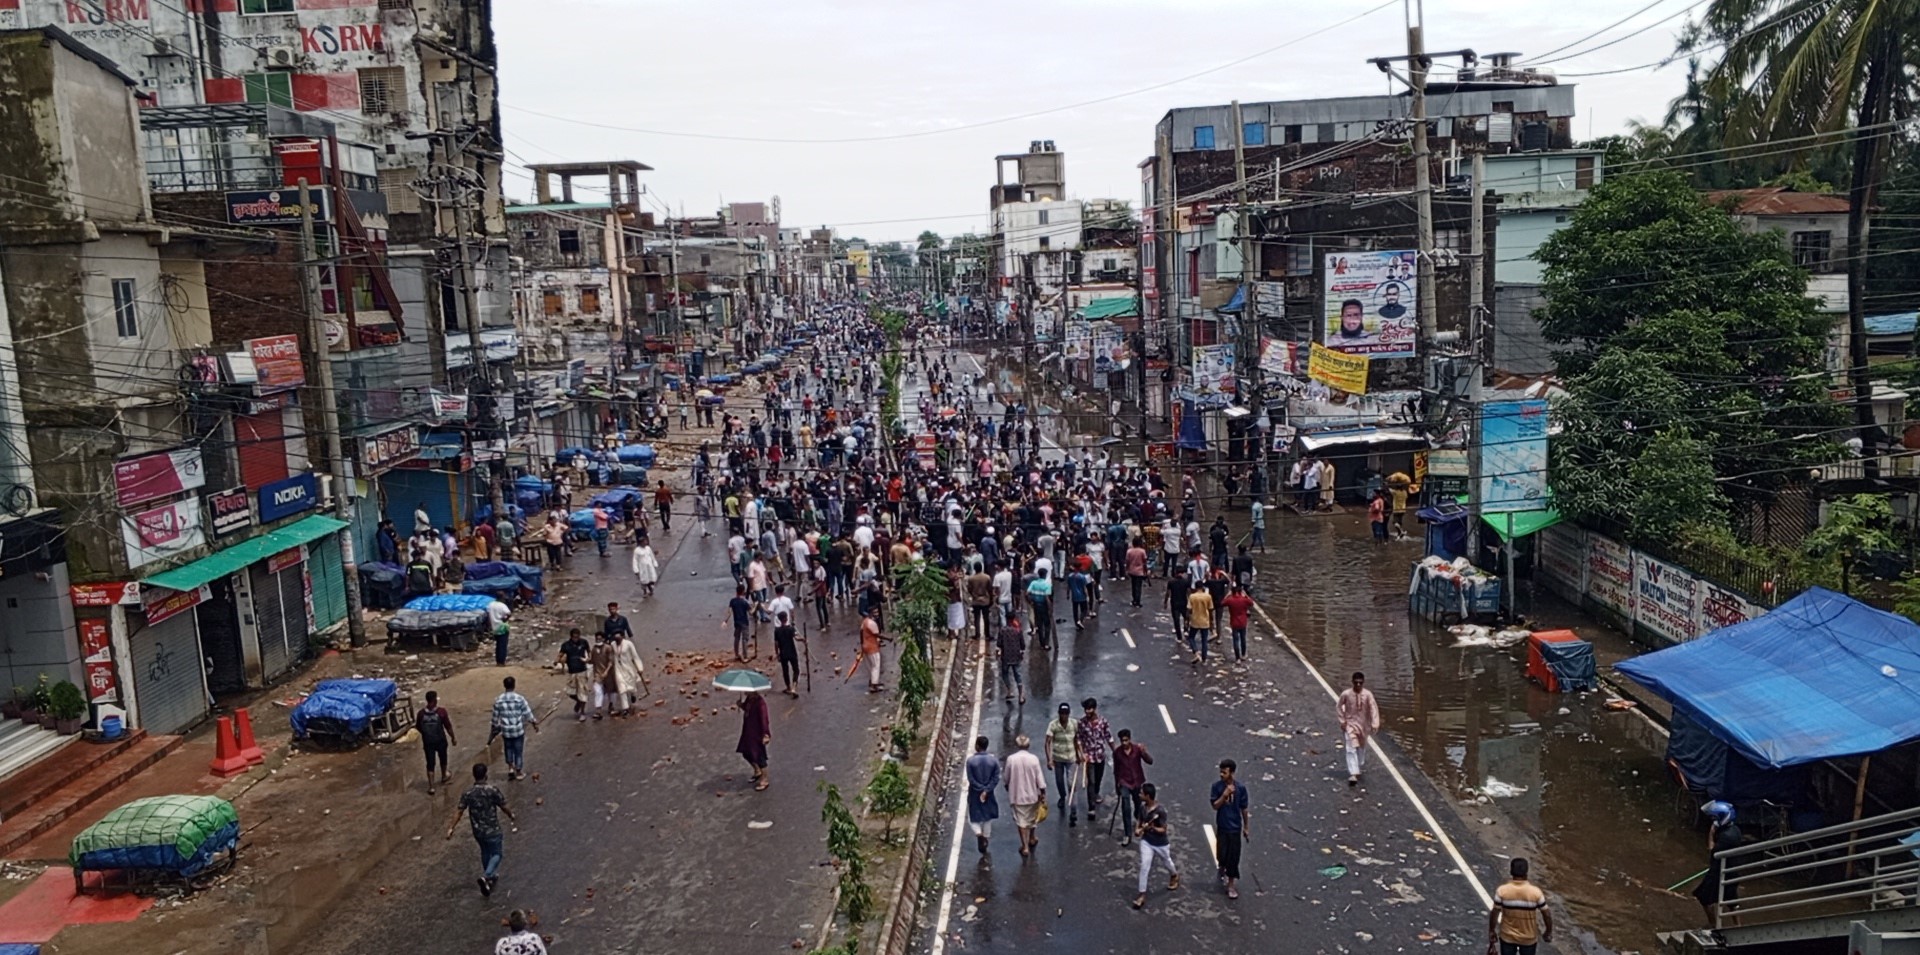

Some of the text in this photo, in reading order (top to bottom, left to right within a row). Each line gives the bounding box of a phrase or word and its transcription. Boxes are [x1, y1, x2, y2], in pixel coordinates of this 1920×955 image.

[66, 0, 149, 25] KSRM
[301, 24, 383, 54] KSRM
[275, 484, 307, 506] NOKIA
[1640, 579, 1666, 604] WALTON
